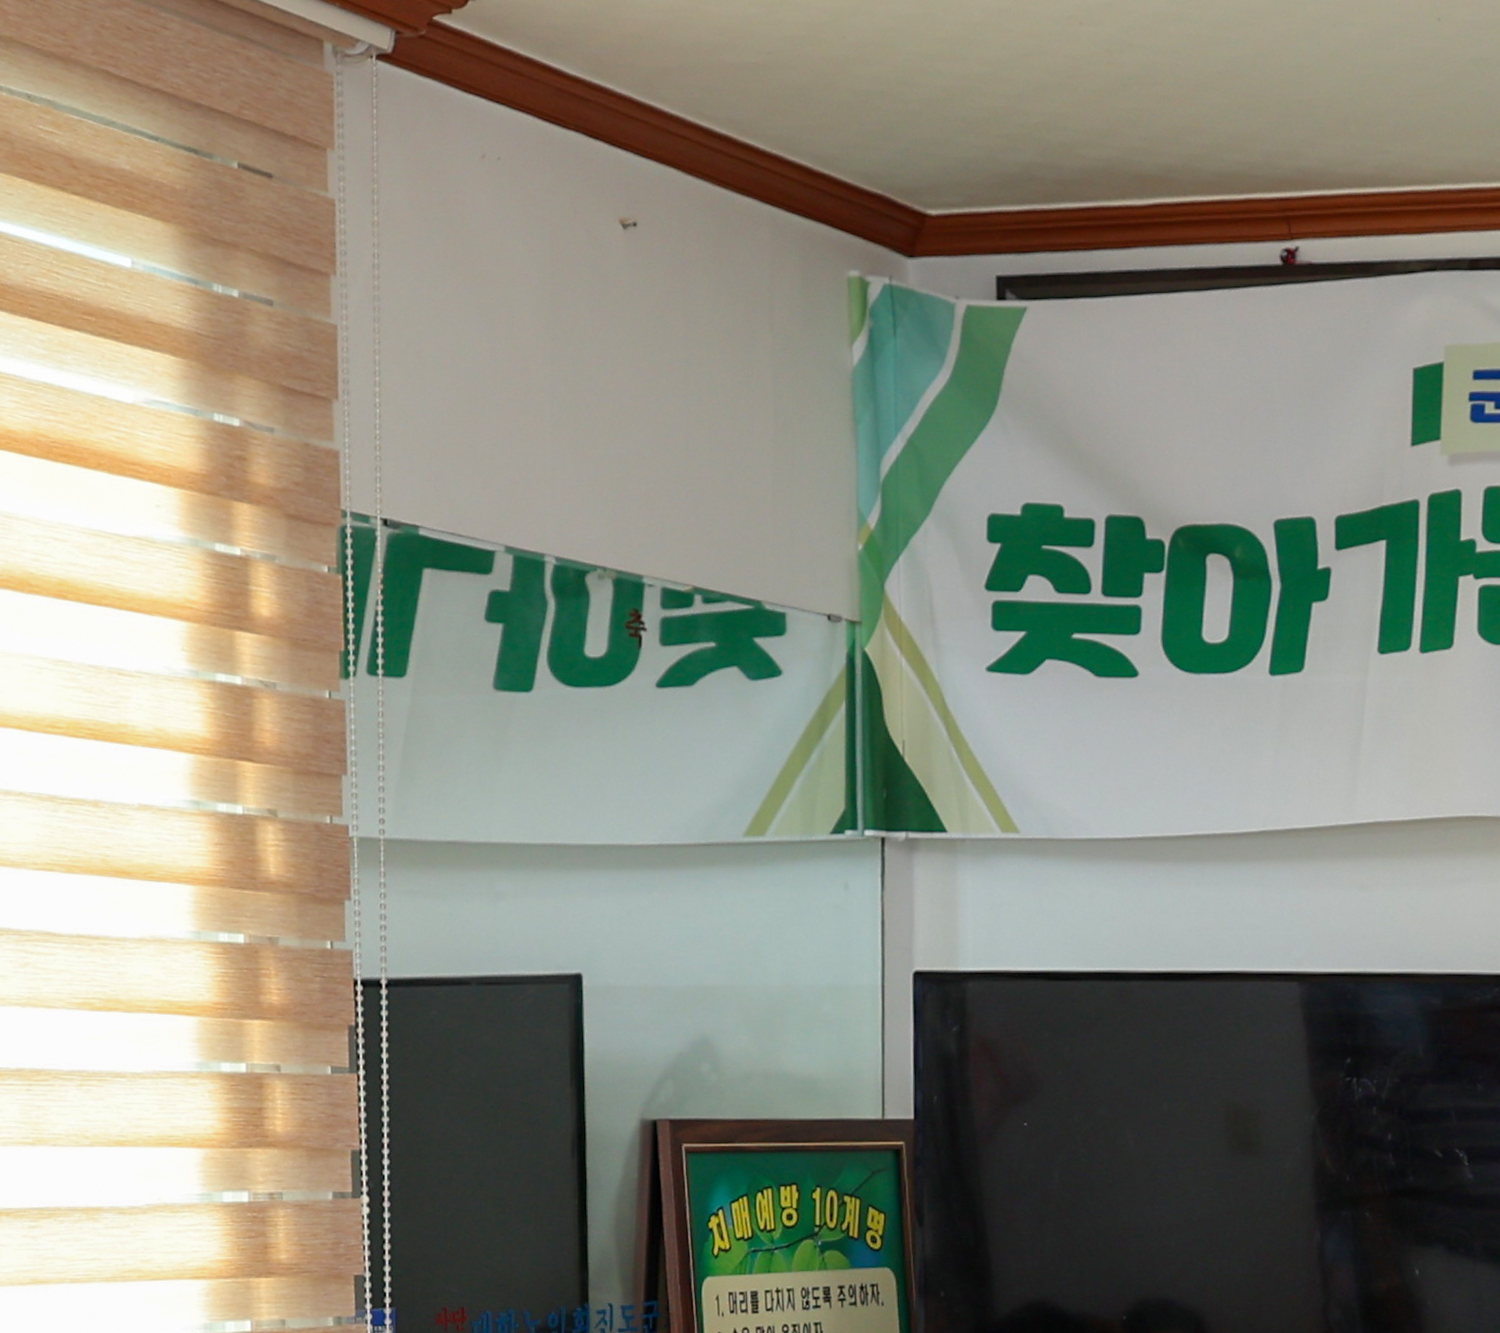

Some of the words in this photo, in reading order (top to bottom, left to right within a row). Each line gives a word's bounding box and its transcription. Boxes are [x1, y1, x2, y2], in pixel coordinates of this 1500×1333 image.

[707, 1184, 800, 1257] 치매예방
[812, 1186, 887, 1252] 10계명
[715, 1295, 724, 1317] 1.
[728, 1290, 759, 1316] 머리를
[764, 1288, 796, 1313] 다치지
[801, 1286, 833, 1310] 않도록
[837, 1283, 886, 1309] 주의하자.
